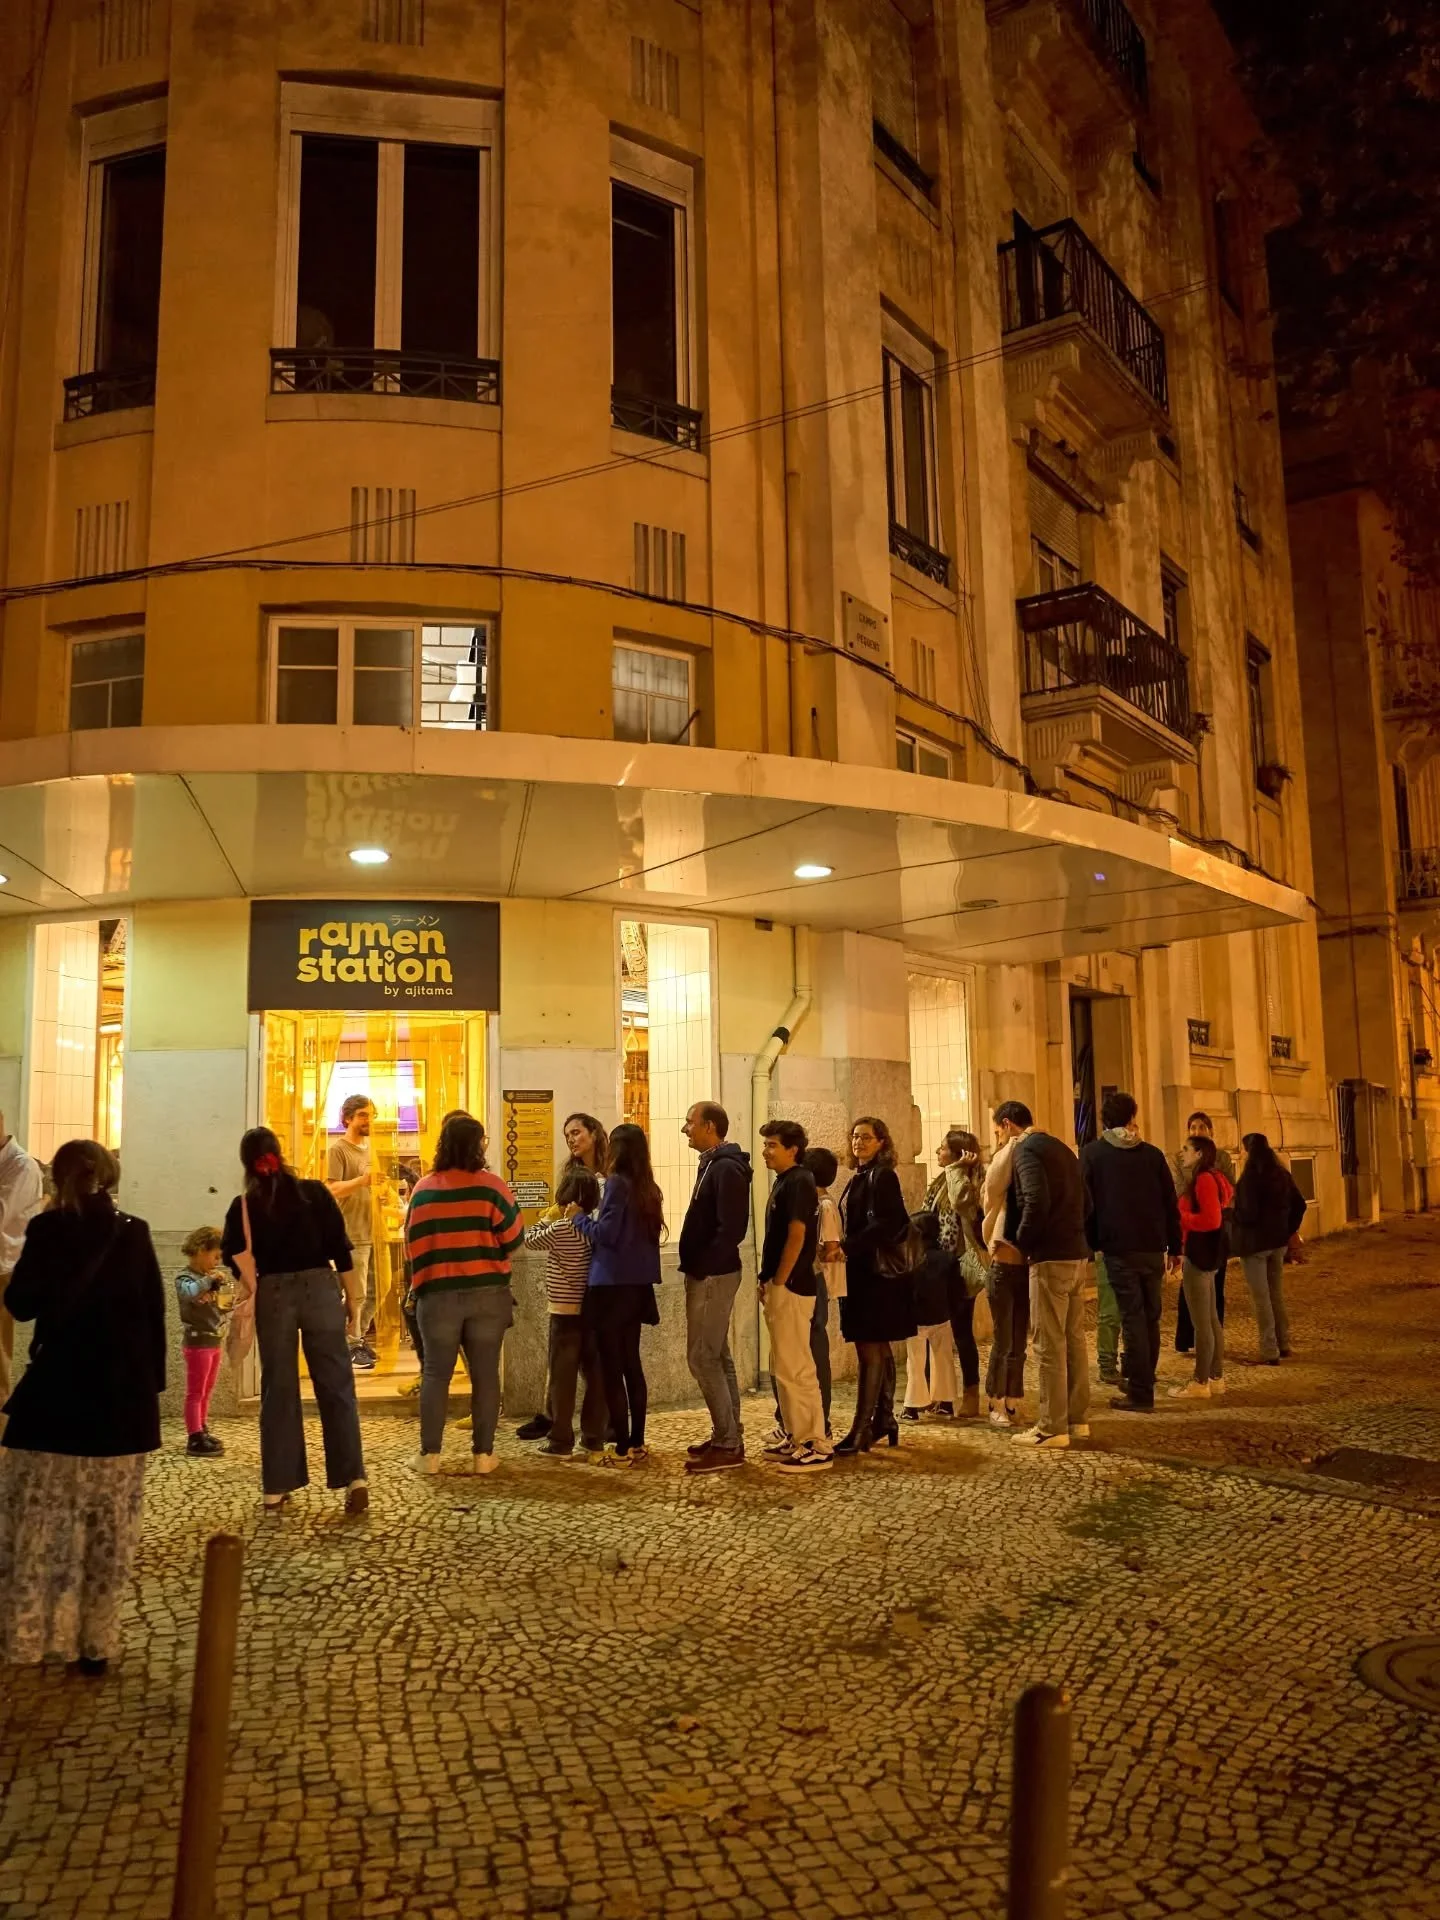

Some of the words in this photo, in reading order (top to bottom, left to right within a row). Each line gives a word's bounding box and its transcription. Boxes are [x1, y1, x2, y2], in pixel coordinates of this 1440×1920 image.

[390, 914, 440, 926] ラーメン
[299, 921, 446, 955] ramen
[296, 949, 453, 983] station
[384, 986, 400, 997] by
[405, 986, 453, 997] ajitama
